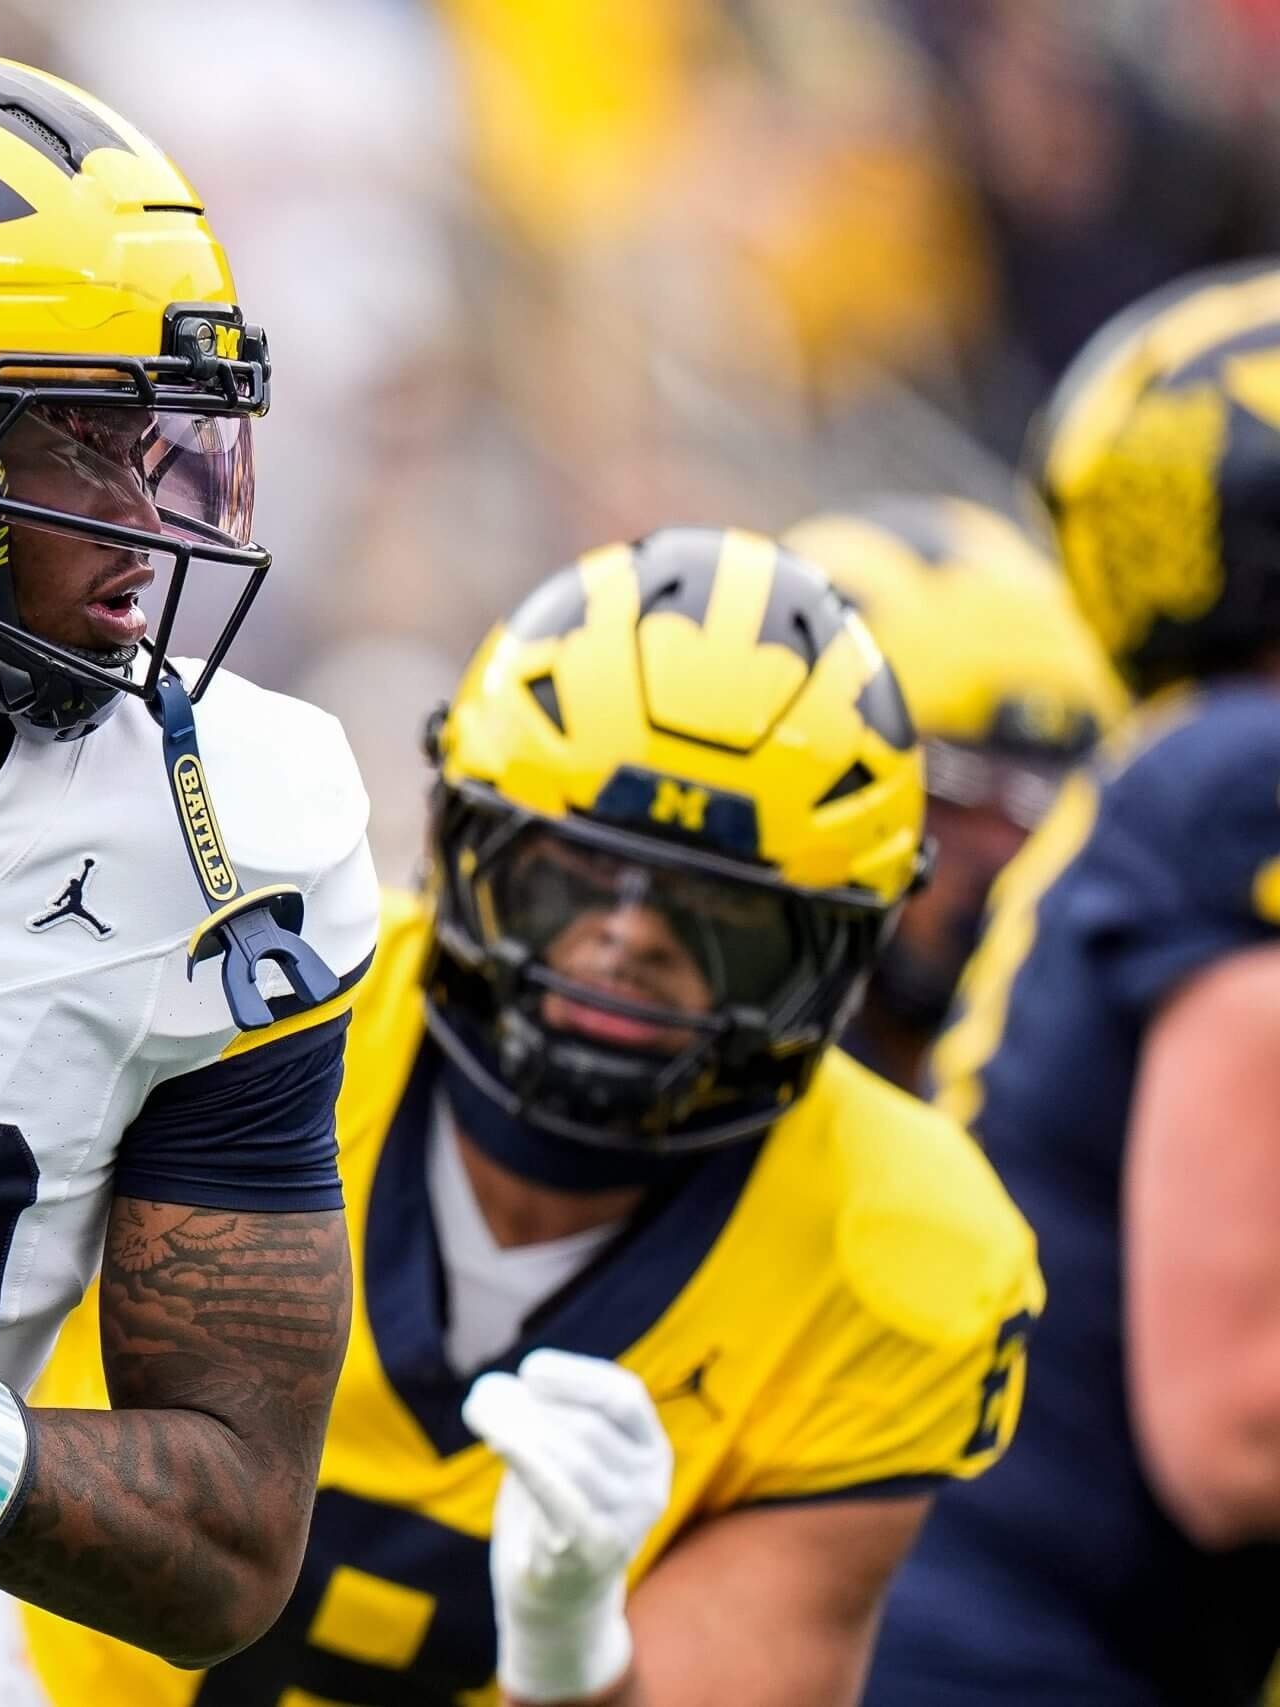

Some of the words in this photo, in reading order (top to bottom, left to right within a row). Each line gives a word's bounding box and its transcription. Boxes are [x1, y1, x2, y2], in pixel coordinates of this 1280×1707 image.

[215, 325, 241, 361] M
[179, 767, 231, 890] BATTLE
[649, 777, 711, 832] M
